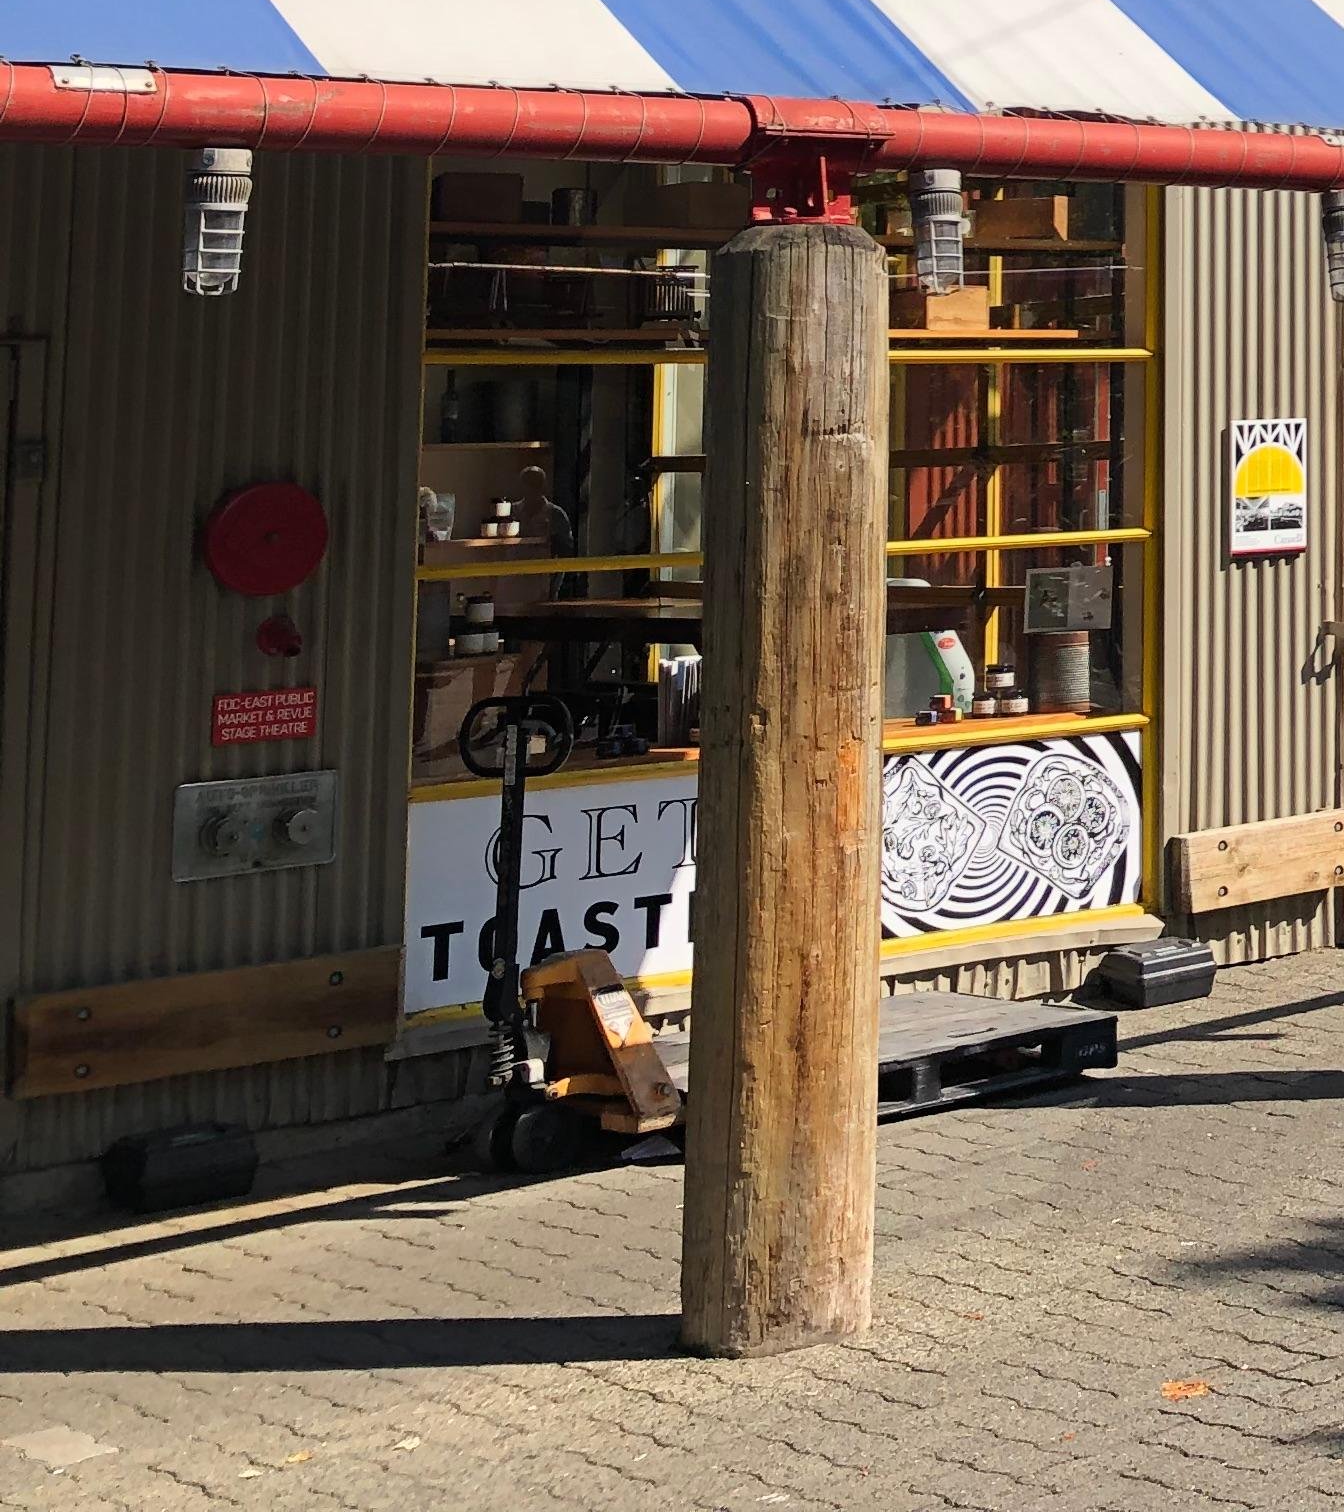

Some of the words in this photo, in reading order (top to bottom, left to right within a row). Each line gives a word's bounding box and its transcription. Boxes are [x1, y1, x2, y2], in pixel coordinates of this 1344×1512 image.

[217, 695, 274, 711] FDC-EAST
[275, 691, 315, 706] PUBLIC
[217, 711, 264, 726] MARKET
[265, 711, 274, 722] &
[276, 706, 313, 721] REVUE
[221, 726, 257, 741] STAGE
[259, 721, 308, 737] THEATRE
[485, 798, 698, 889] GET
[420, 891, 697, 982] TAST
